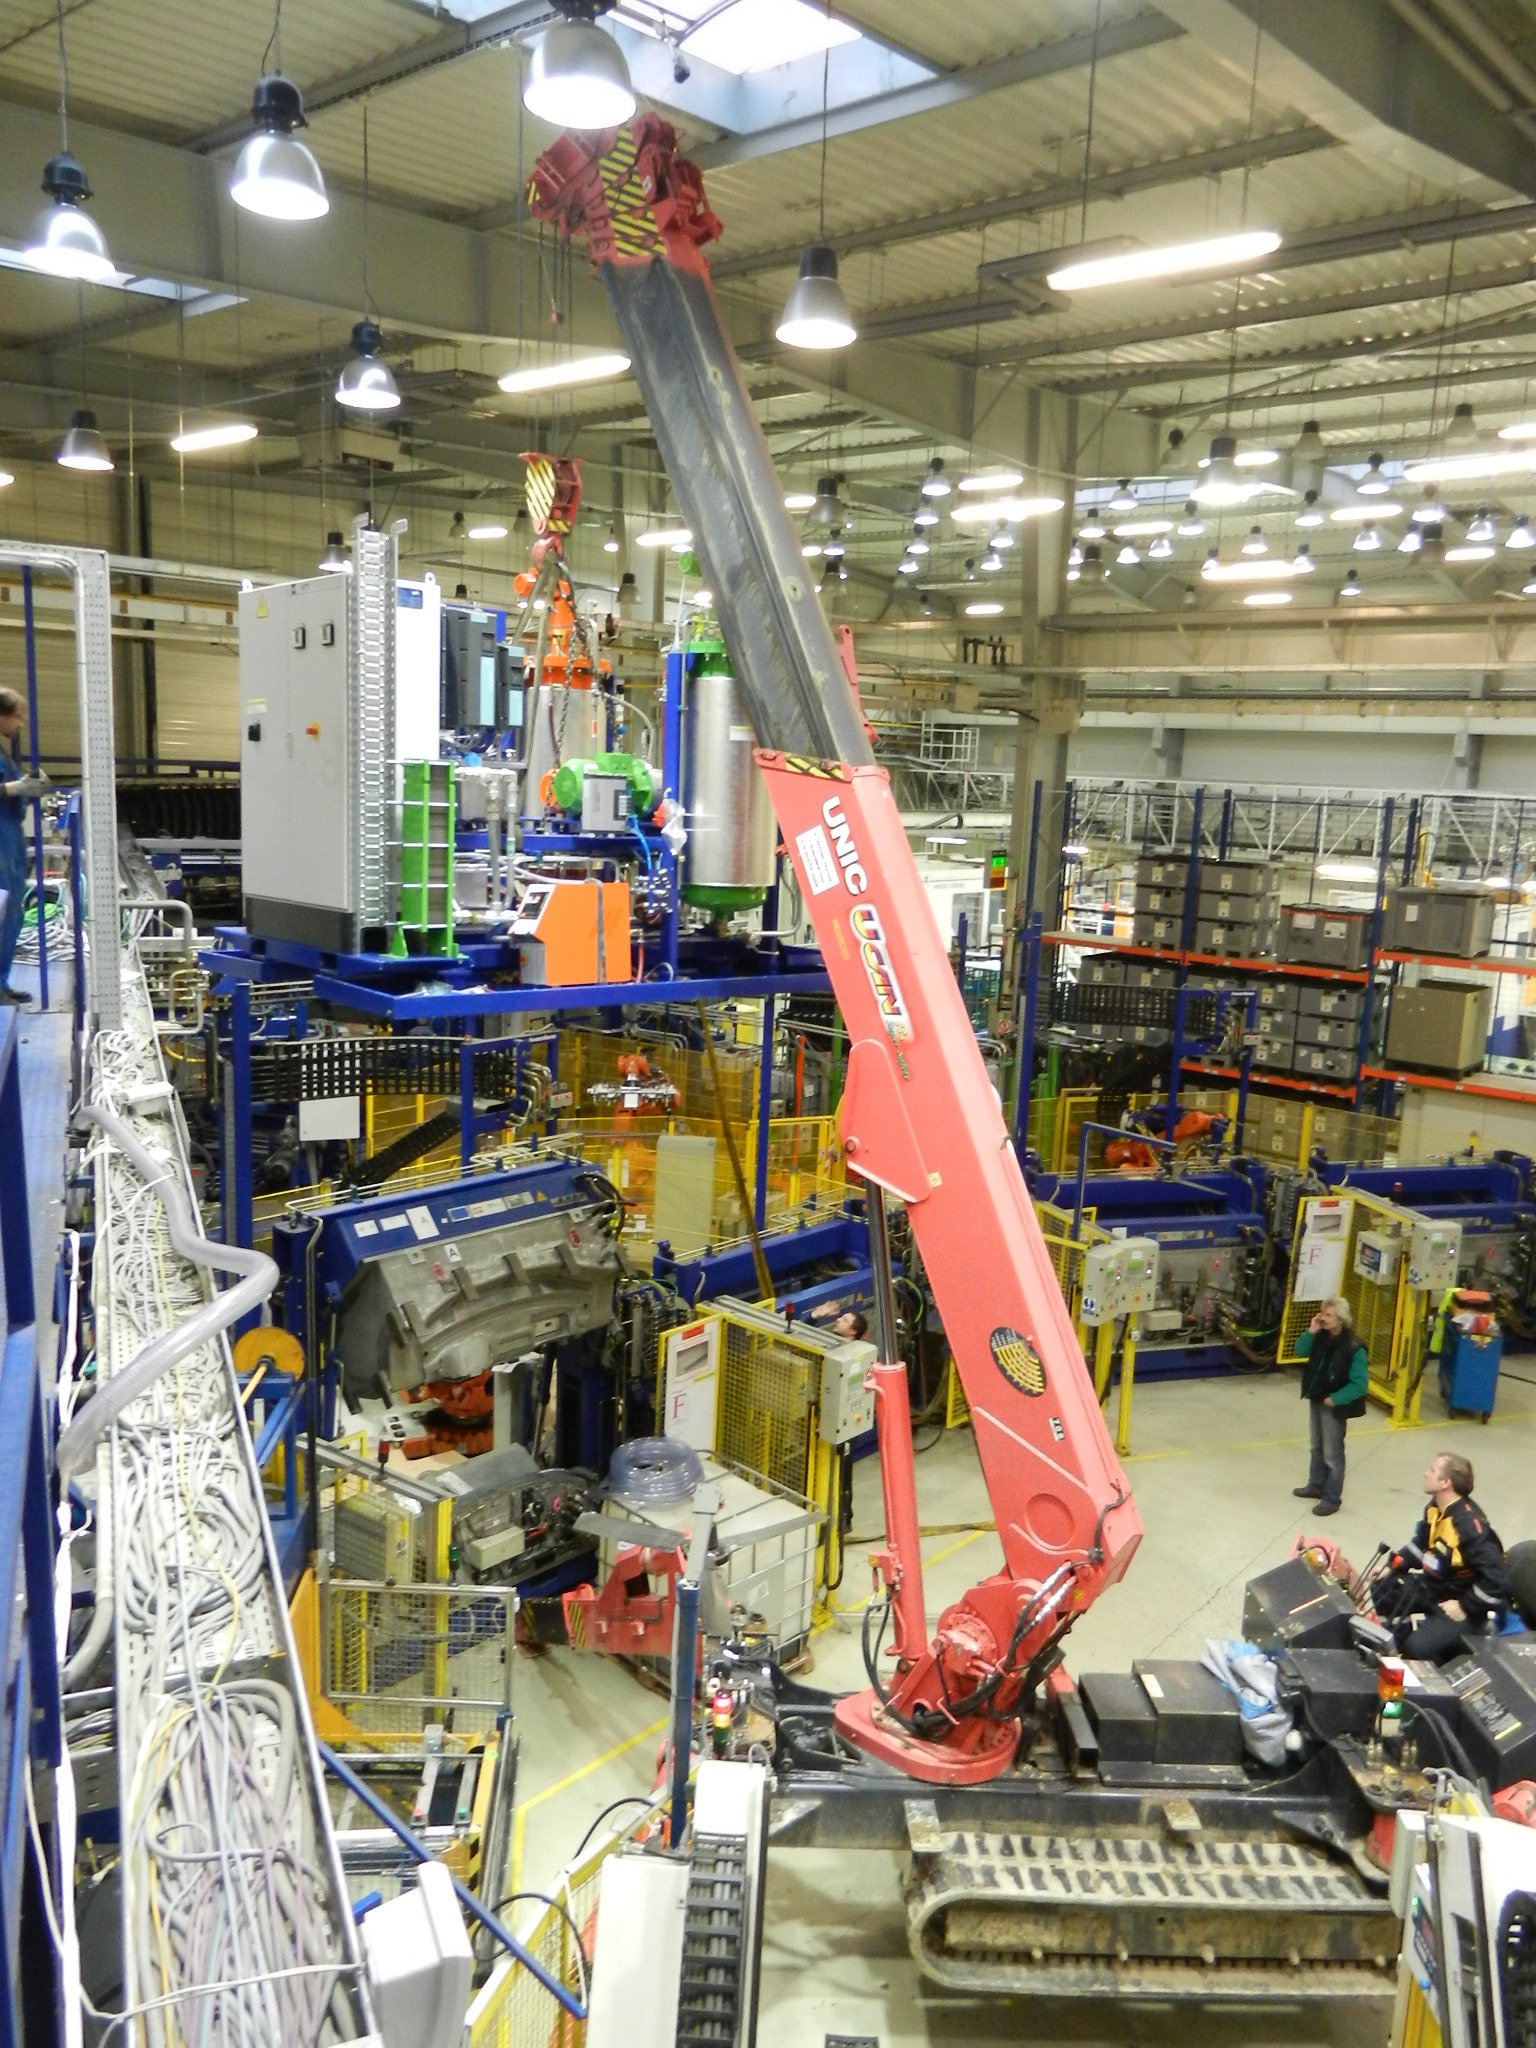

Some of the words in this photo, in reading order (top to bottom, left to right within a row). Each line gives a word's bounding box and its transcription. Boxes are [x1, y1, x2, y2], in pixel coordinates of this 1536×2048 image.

[822, 796, 867, 896] UNIC
[1309, 1247, 1322, 1265] F
[672, 1393, 687, 1420] F
